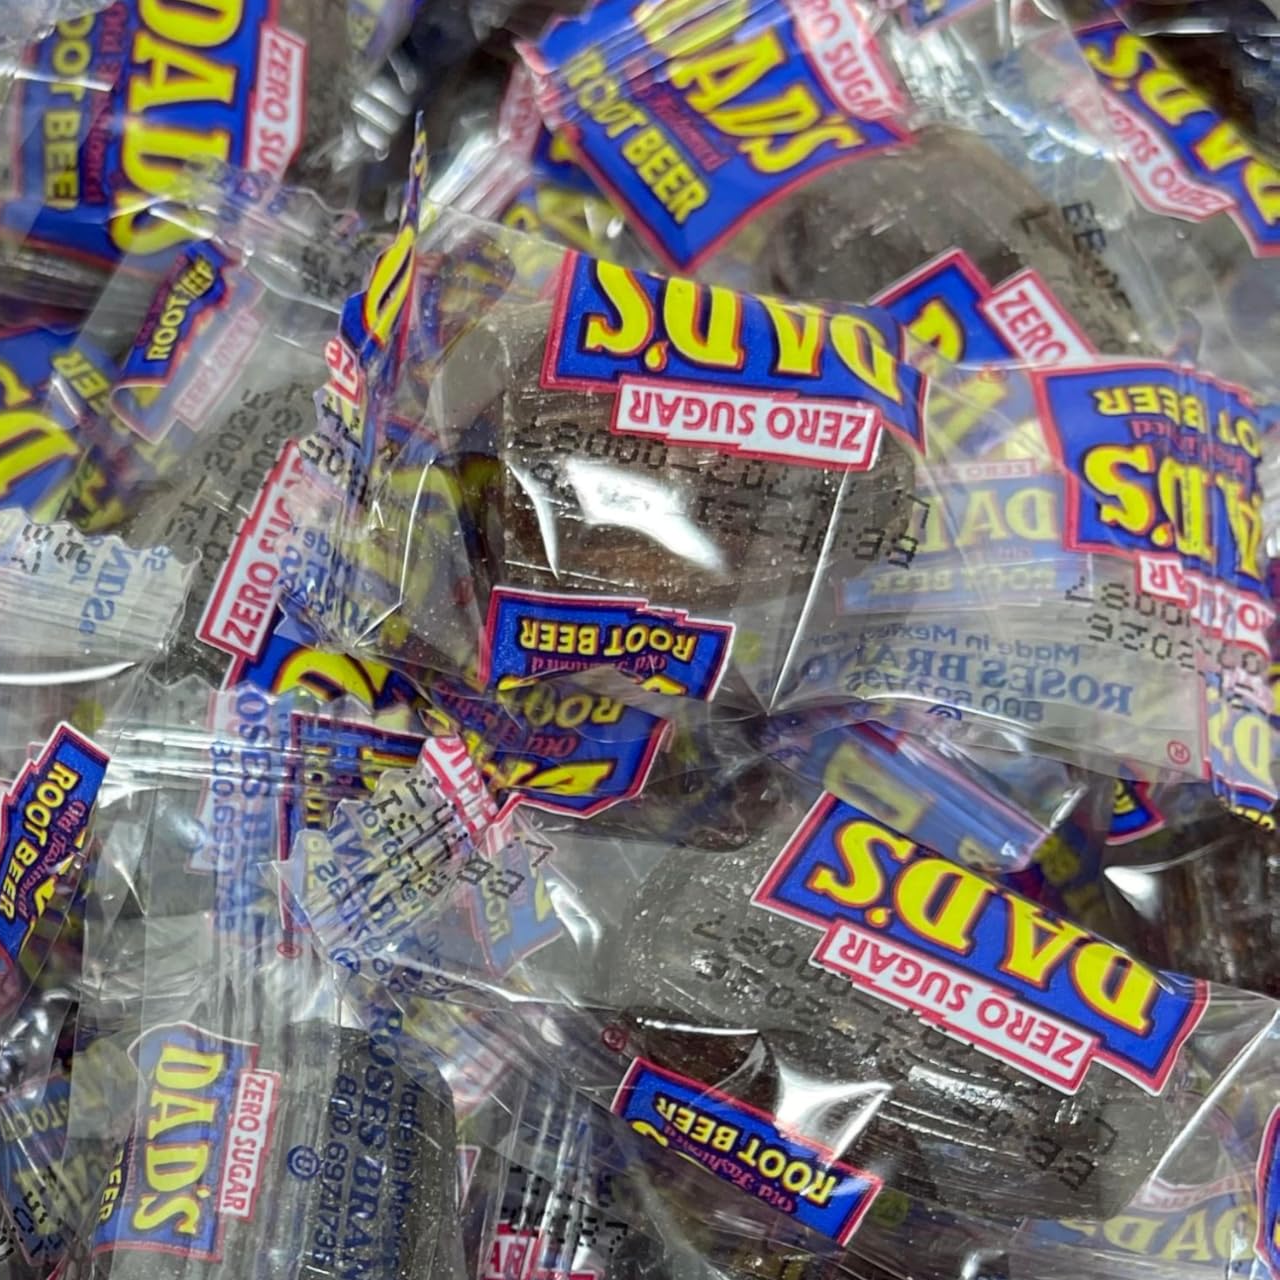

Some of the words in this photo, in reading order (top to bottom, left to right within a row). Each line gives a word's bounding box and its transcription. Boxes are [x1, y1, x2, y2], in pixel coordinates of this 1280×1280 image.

[260, 44, 294, 123] ZERO
[620, 130, 710, 222] BEER
[145, 295, 190, 360] ROOT
[628, 390, 753, 435] SUGAR
[766, 413, 866, 450] ZERO
[222, 560, 278, 656] ZERO
[520, 617, 600, 650] BEER
[607, 622, 698, 662] ROOT
[25, 763, 78, 848] ROOT
[0, 840, 45, 920] BEER
[810, 820, 1158, 1033] DAD'S
[838, 930, 973, 998] SUGAR
[977, 997, 1086, 1066] ZERO
[236, 1072, 276, 1135] ZERO
[357, 1003, 404, 1148] ROSES
[132, 1045, 224, 1236] DAD'S
[656, 1097, 738, 1153] BEER
[222, 1132, 264, 1214] SUGAR
[734, 1132, 836, 1206] ROOT
